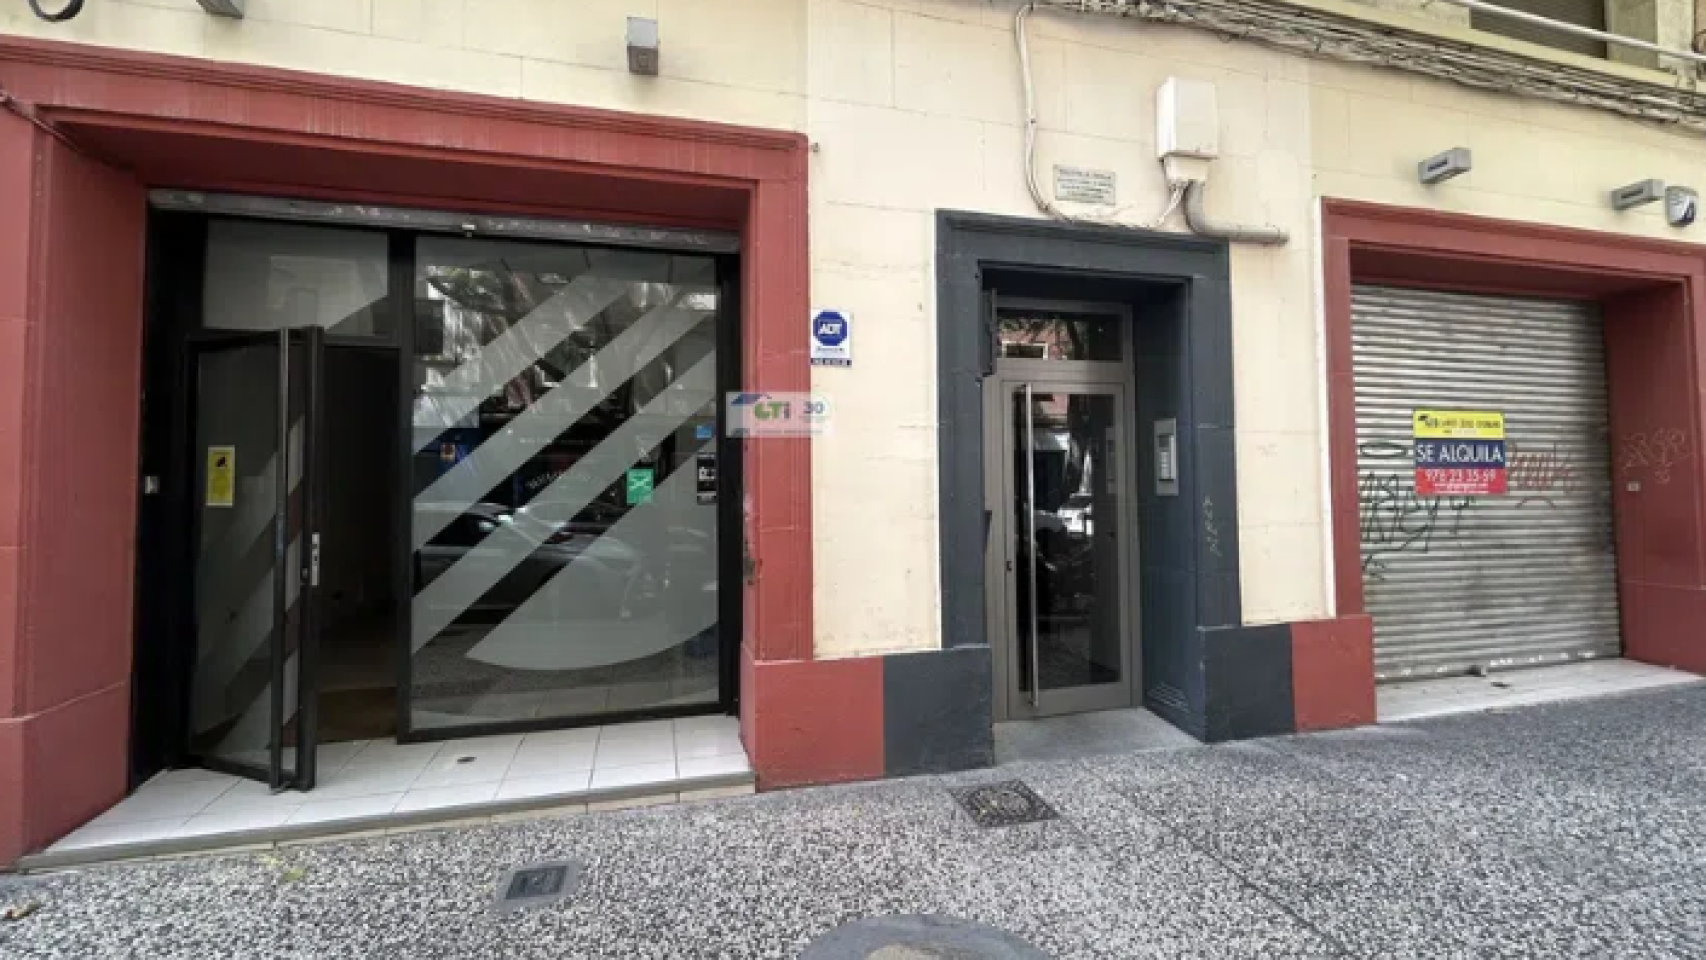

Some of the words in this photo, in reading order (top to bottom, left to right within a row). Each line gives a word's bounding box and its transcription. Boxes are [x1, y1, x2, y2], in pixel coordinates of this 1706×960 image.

[818, 323, 842, 335] ADT
[1417, 443, 1435, 463] SE
[1440, 443, 1504, 463] ALQUILA
